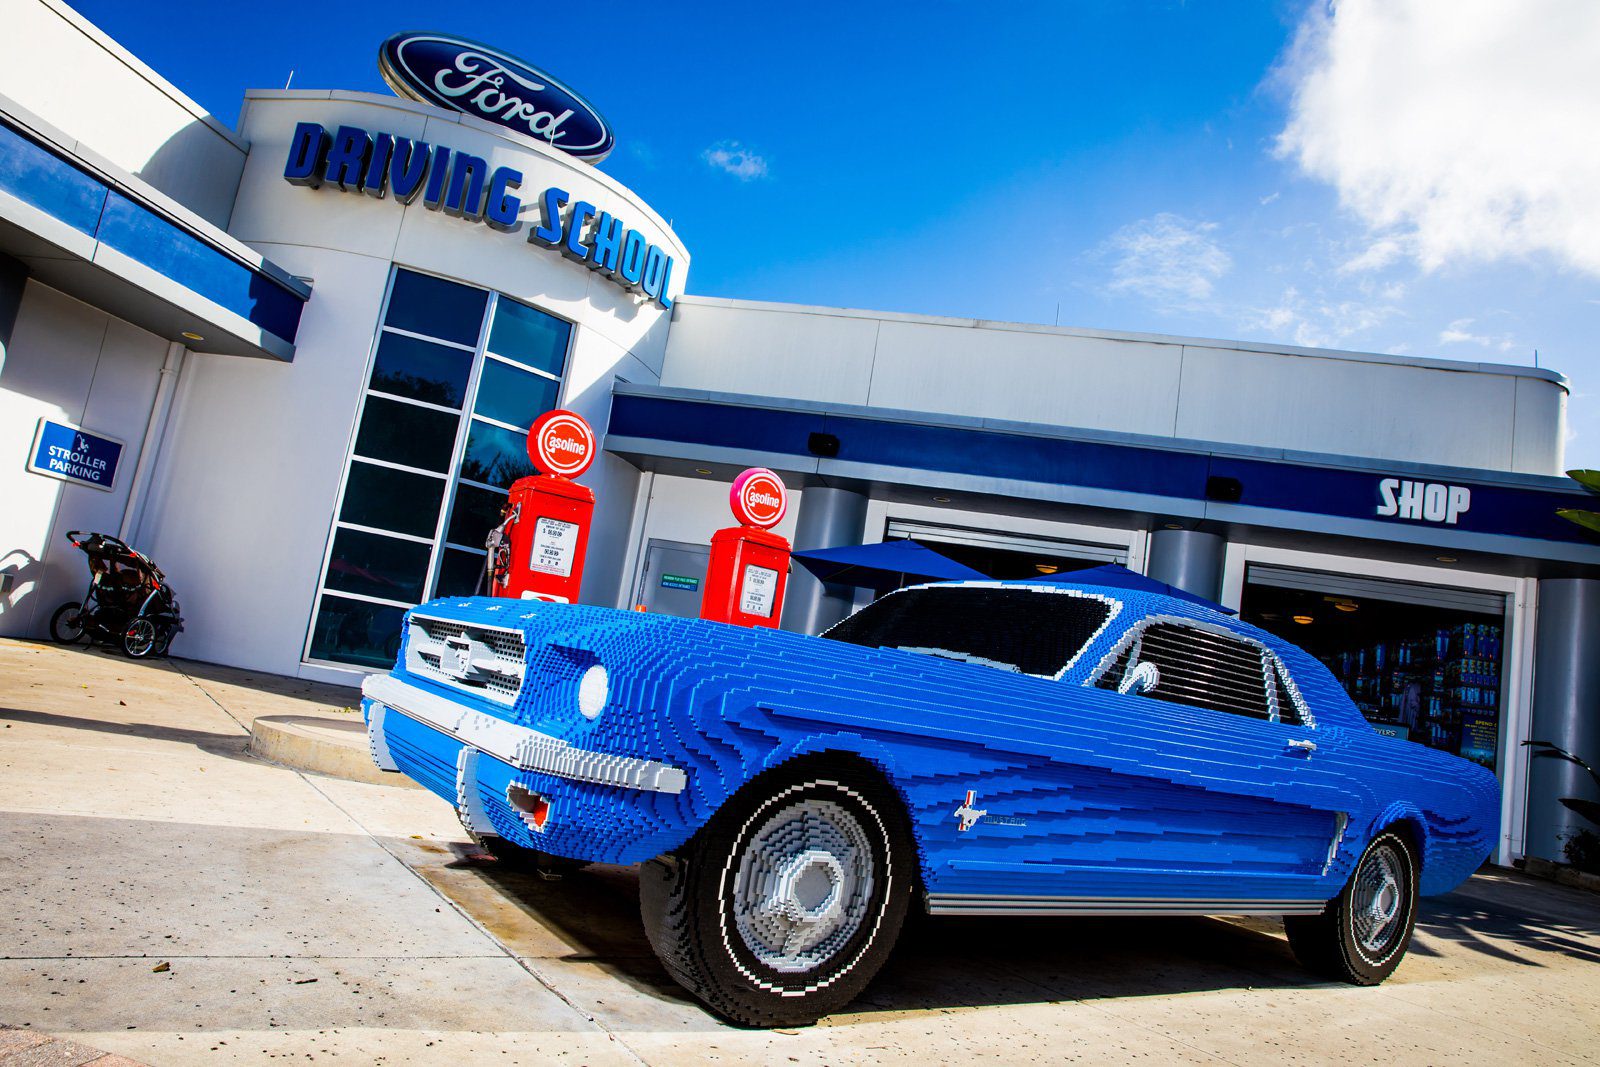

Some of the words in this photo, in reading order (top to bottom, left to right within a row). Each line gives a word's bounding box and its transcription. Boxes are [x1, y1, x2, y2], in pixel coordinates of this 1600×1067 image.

[434, 51, 575, 141] Ford
[284, 122, 525, 228] DRIVING
[529, 187, 674, 310] SCHOOL
[544, 429, 586, 456] Gasoline
[48, 445, 107, 471] STROLLER
[49, 458, 101, 481] PARKING
[745, 485, 780, 508] Gasoline
[1377, 478, 1471, 524] SHOP
[983, 815, 1026, 826] MUSTANG
